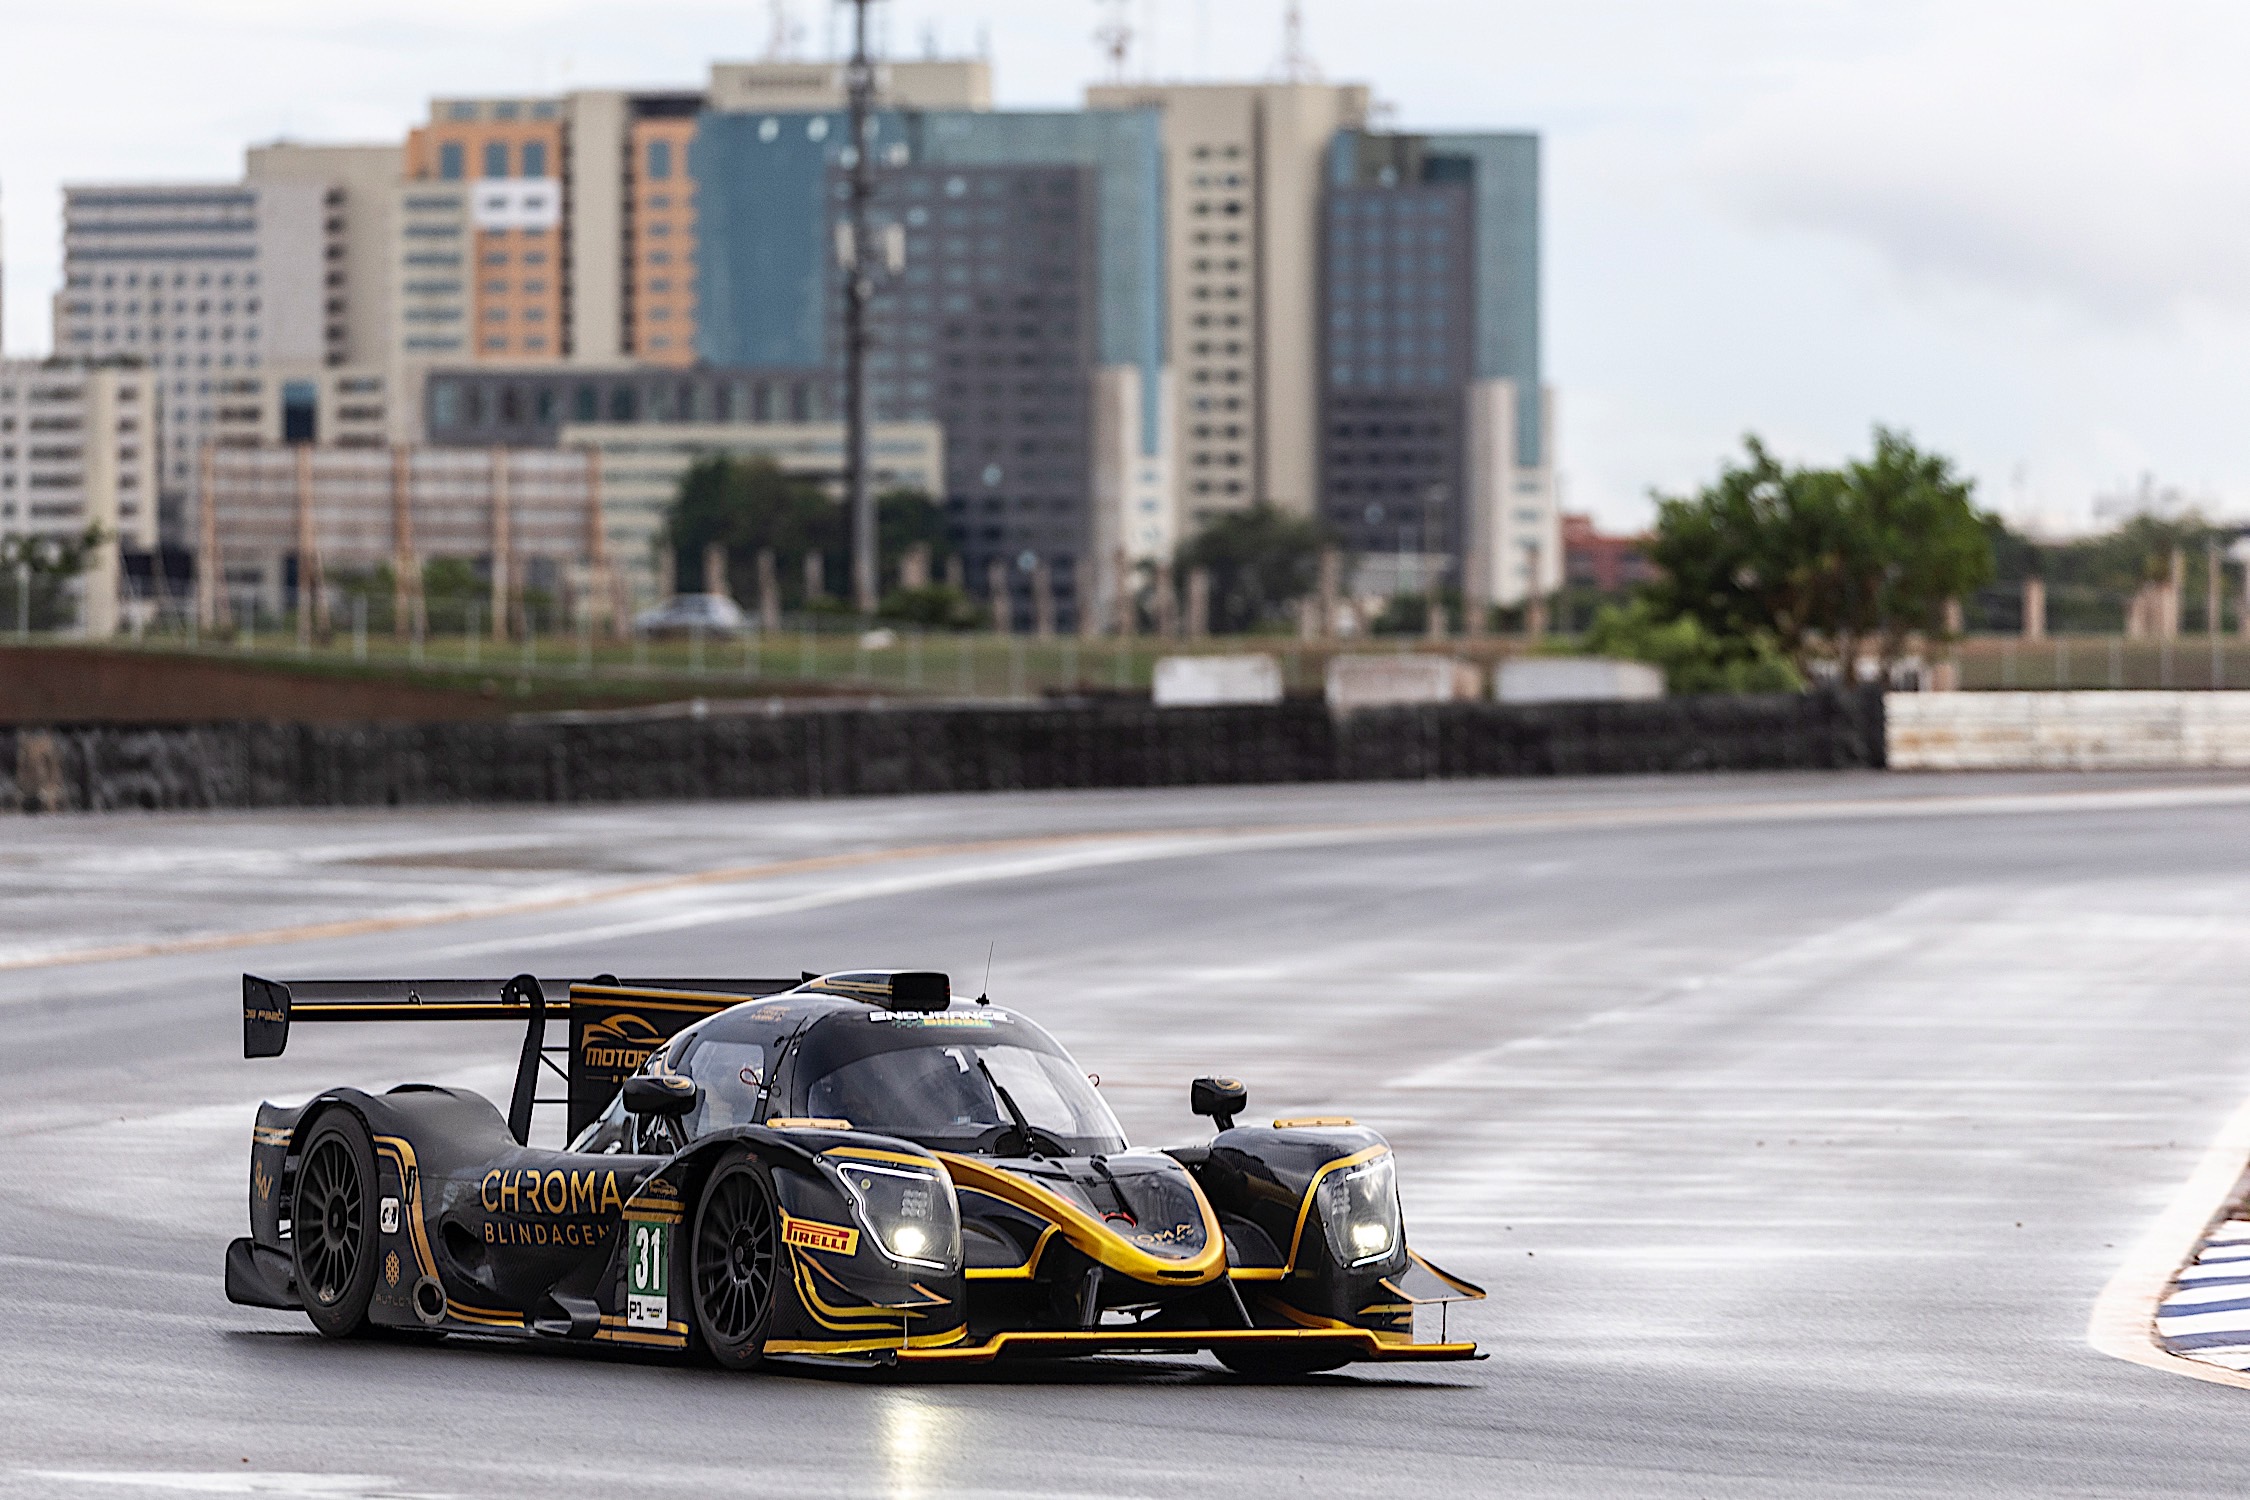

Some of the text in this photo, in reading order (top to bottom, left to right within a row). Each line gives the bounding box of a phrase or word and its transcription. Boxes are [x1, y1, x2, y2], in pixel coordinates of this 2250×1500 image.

[869, 1010, 1008, 1022] ENDURANCE
[481, 1169, 623, 1214] CHROMA
[786, 1220, 850, 1251] PIRELLI
[635, 1227, 661, 1290] 31
[628, 1301, 644, 1320] P1
